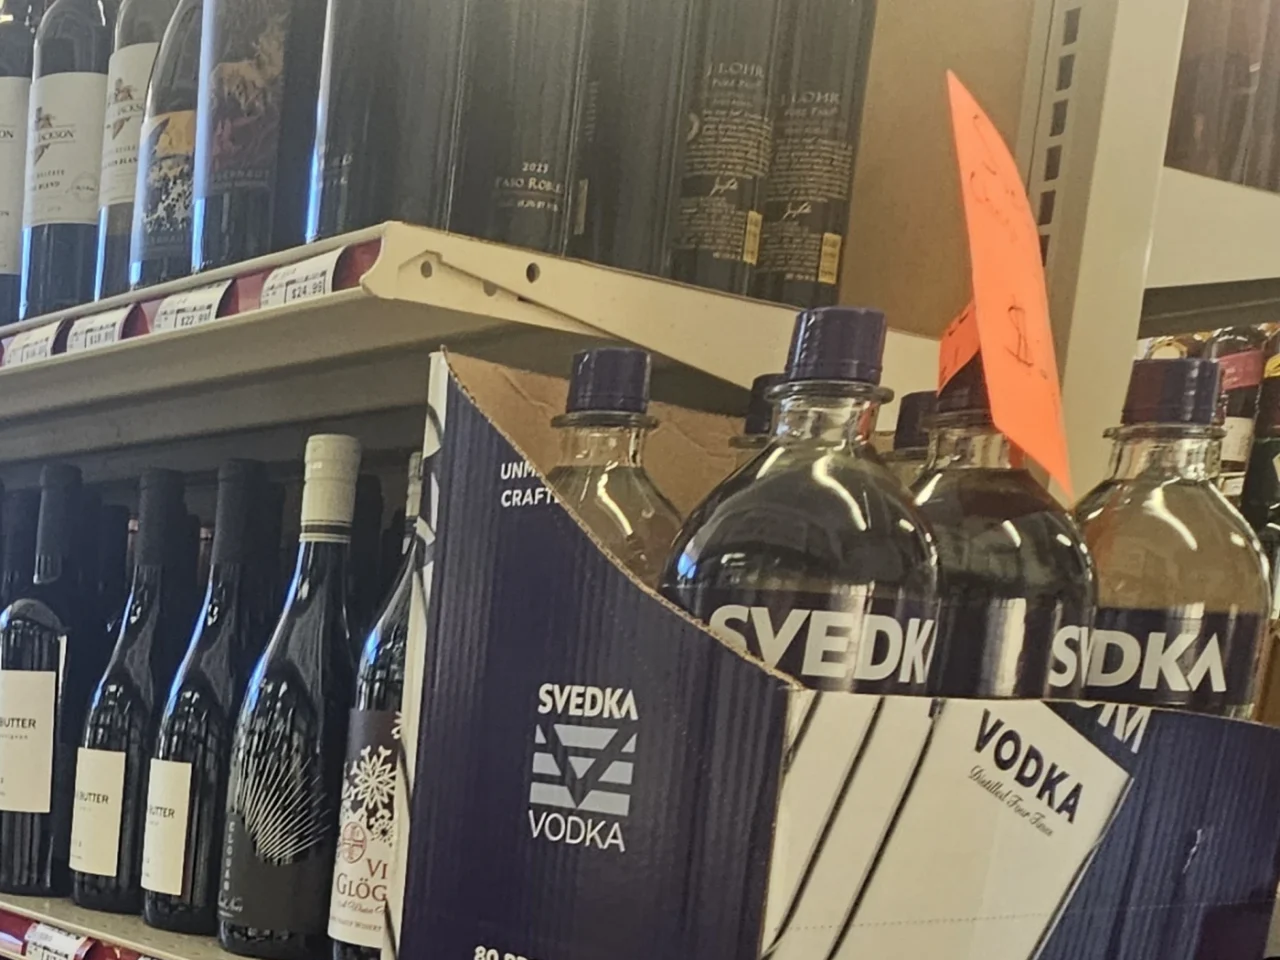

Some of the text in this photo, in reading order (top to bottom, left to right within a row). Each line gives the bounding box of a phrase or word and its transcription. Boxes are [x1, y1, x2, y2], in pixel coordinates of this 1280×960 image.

[500, 487, 560, 508] CRAFT
[710, 604, 935, 684] SVEDK
[538, 682, 638, 721] SVEDKA
[974, 708, 1084, 824] VODKA
[528, 809, 626, 852] VODKA
[337, 872, 388, 902] GLÖG
[366, 858, 388, 879] VI
